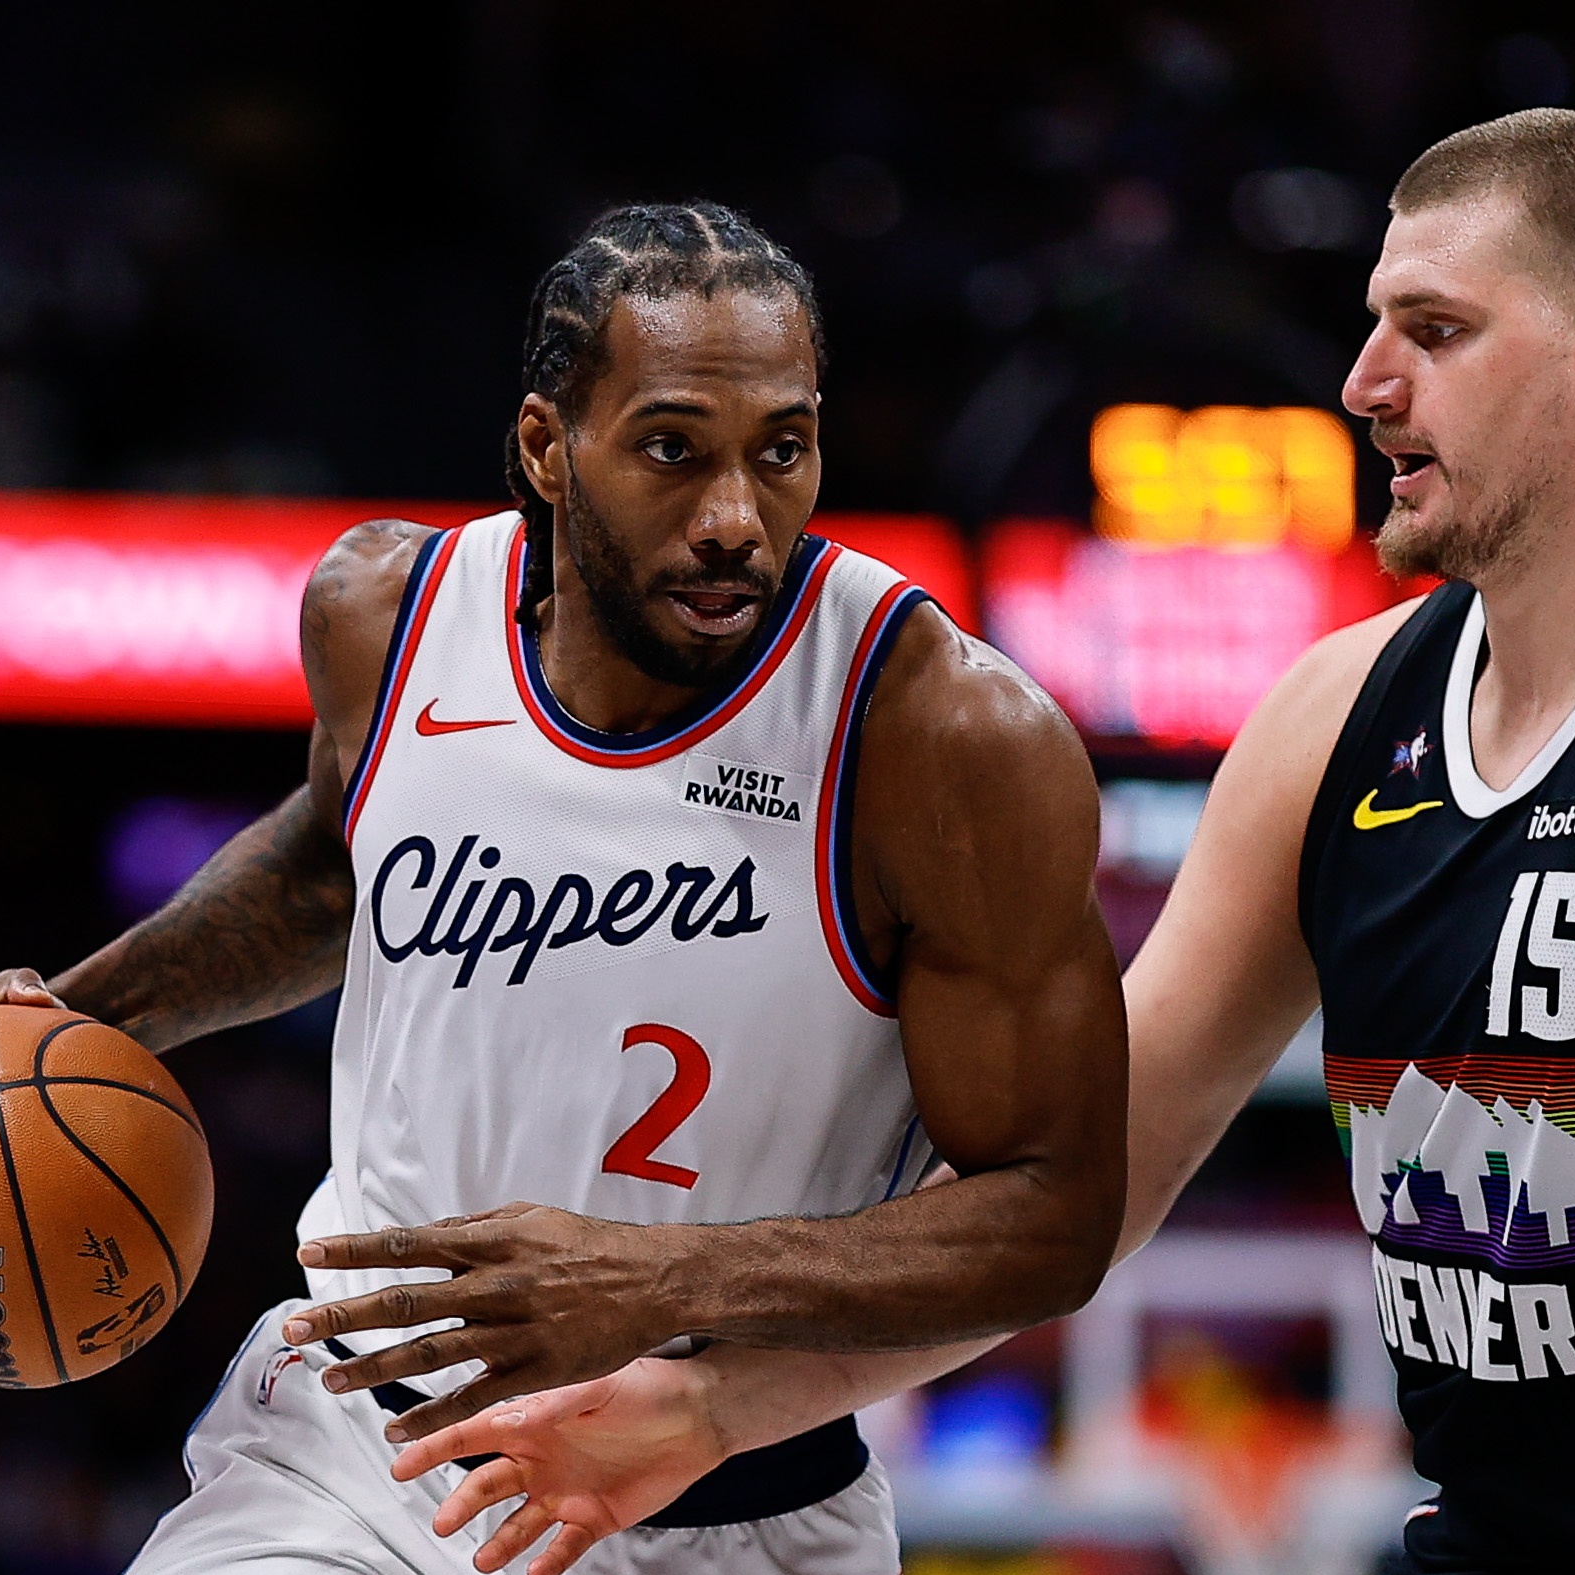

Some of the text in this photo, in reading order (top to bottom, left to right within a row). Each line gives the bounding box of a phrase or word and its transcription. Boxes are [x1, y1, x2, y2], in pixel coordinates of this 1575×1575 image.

[684, 781, 801, 822] RWANDA
[717, 764, 785, 796] VISIT
[370, 833, 770, 989] Clippers
[601, 1023, 712, 1191] 2
